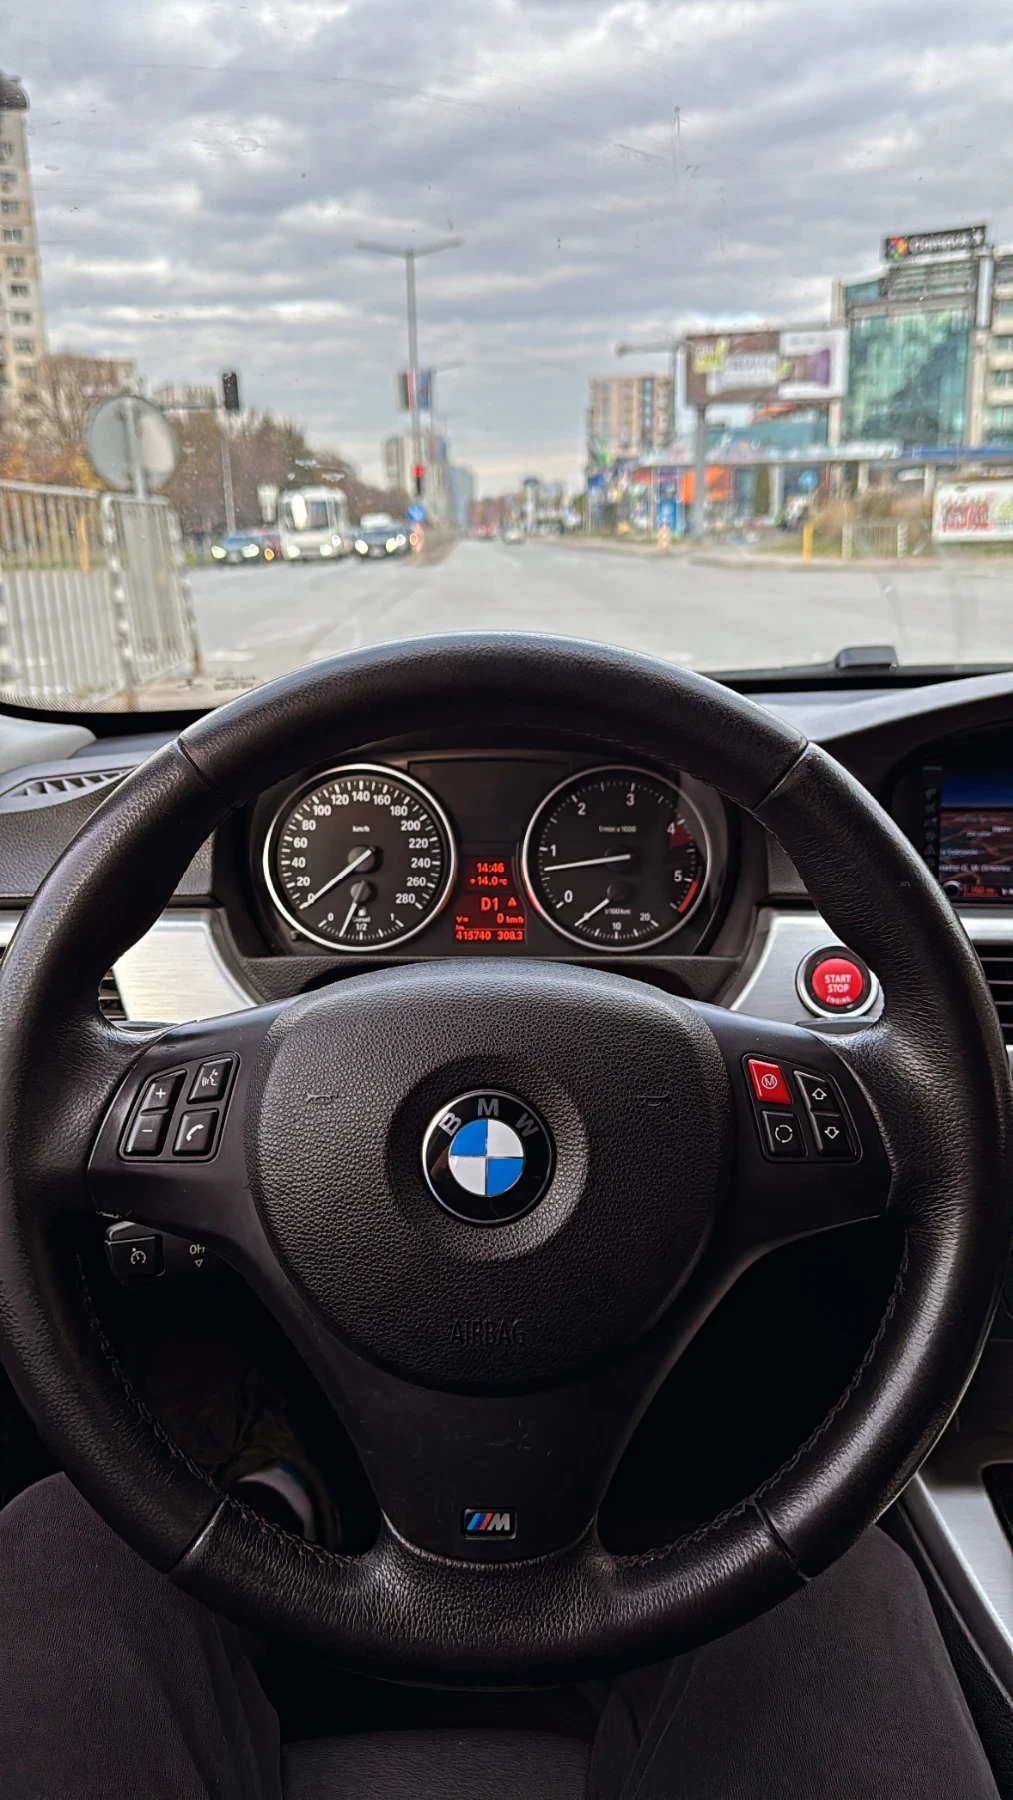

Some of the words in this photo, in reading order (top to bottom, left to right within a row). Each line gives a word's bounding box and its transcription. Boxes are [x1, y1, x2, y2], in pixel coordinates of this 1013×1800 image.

[331, 794, 349, 805] 120
[352, 791, 370, 802] 140
[373, 795, 391, 805] 160
[626, 793, 635, 806] 3
[313, 805, 331, 816] 100
[390, 805, 408, 816] 180
[577, 803, 586, 815] 2
[302, 819, 316, 831] 80
[400, 820, 421, 831] 200
[667, 823, 676, 834] 4
[293, 837, 308, 848] 60
[409, 838, 428, 849] 220
[550, 844, 557, 856] 1
[291, 857, 306, 868] 40
[411, 857, 431, 868] 240
[476, 862, 505, 873] 14:46
[296, 876, 311, 887] 20
[674, 870, 682, 882] 5
[406, 876, 426, 888] 260
[307, 893, 316, 904] 0
[396, 893, 415, 904] 280
[564, 890, 573, 903] 0
[480, 897, 498, 911] D1
[328, 913, 334, 921] 0
[390, 913, 394, 921] 1
[497, 913, 504, 924] 0
[640, 913, 650, 921] 20
[356, 923, 367, 931] 1/2
[612, 922, 621, 930] 10
[456, 930, 492, 941] 415740
[497, 930, 523, 941] 308.3
[824, 974, 852, 984] START
[827, 984, 850, 993] STOP
[826, 995, 852, 1005] ENGINE
[764, 1077, 775, 1086] M
[438, 1098, 539, 1138] BMW
[449, 1319, 524, 1346] AIRBAG
